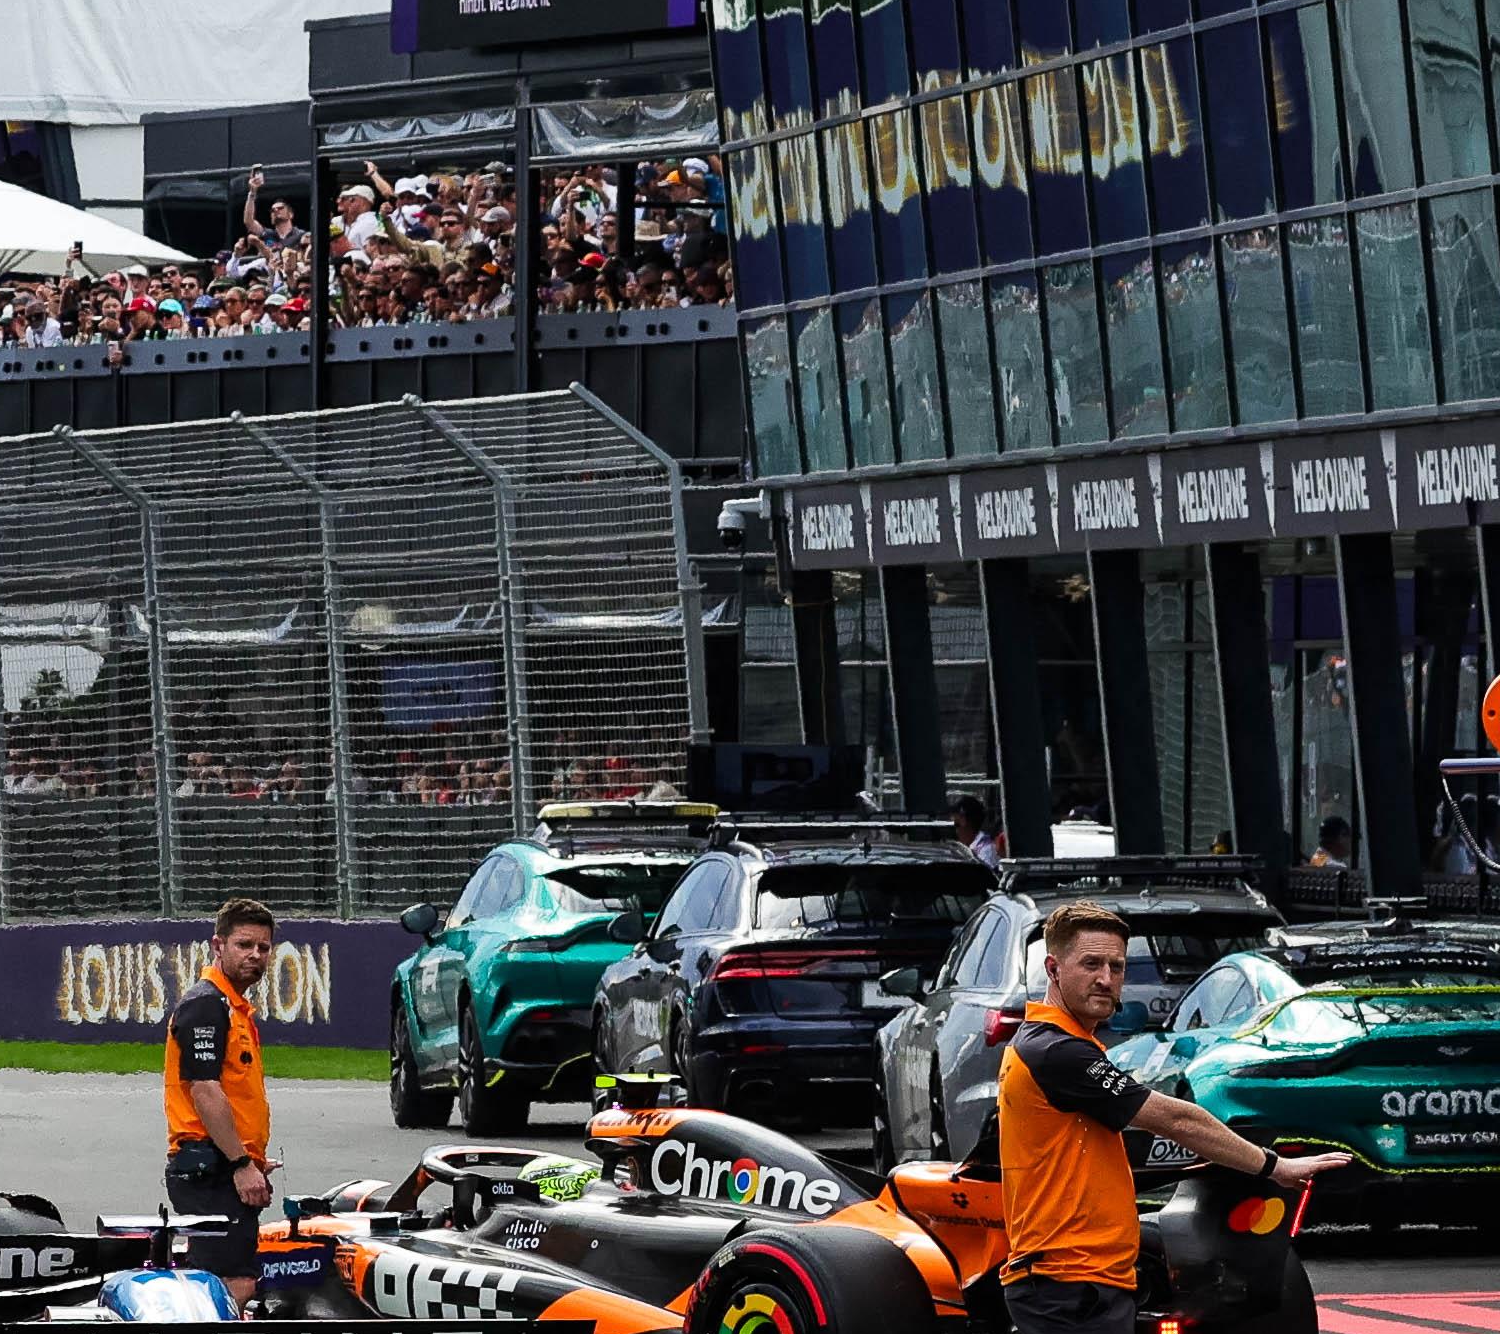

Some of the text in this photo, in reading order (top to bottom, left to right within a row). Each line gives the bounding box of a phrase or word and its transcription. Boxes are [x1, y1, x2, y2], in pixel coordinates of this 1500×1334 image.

[1177, 468, 1249, 523] MELBOURNE
[1291, 457, 1371, 514] MELBOURNE
[1416, 444, 1499, 505] MELBOURNE
[802, 503, 854, 550] MELBOURNE
[884, 497, 941, 544] MELBOURNE
[975, 488, 1037, 539] MELBOURNE
[1073, 477, 1140, 531] MELBOURNE
[61, 942, 165, 1024] LOUIS
[492, 1181, 515, 1196] okta
[652, 1139, 841, 1215] Chrome
